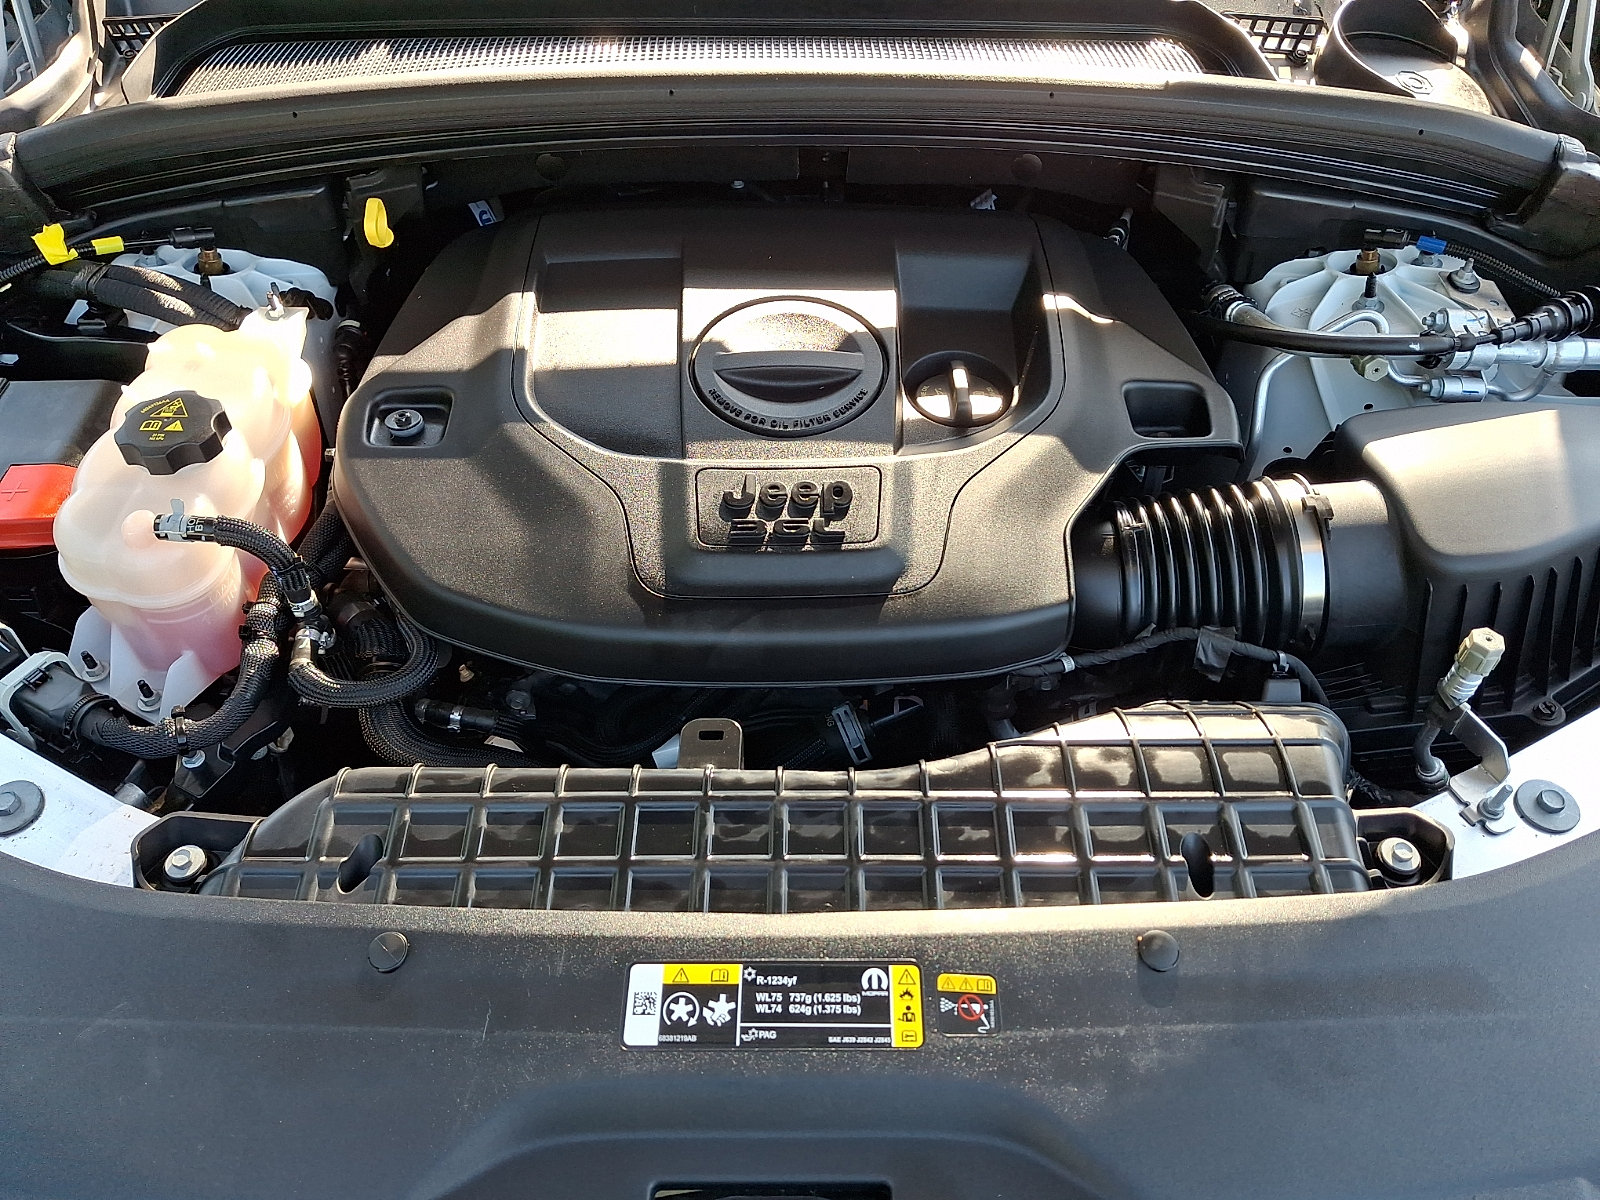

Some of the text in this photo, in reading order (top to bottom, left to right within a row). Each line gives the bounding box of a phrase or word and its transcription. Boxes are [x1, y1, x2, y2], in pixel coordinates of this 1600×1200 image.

[708, 388, 869, 429] REMOVE FOR OIL FILTER SERVICE
[721, 473, 853, 516] Jeep
[756, 975, 798, 987] R-1234yf
[755, 992, 861, 1004] WL75 737g (1.625 lbs)
[755, 1004, 861, 1016] WL74 624g (1.375 lbs)
[758, 1030, 777, 1039] PAG
